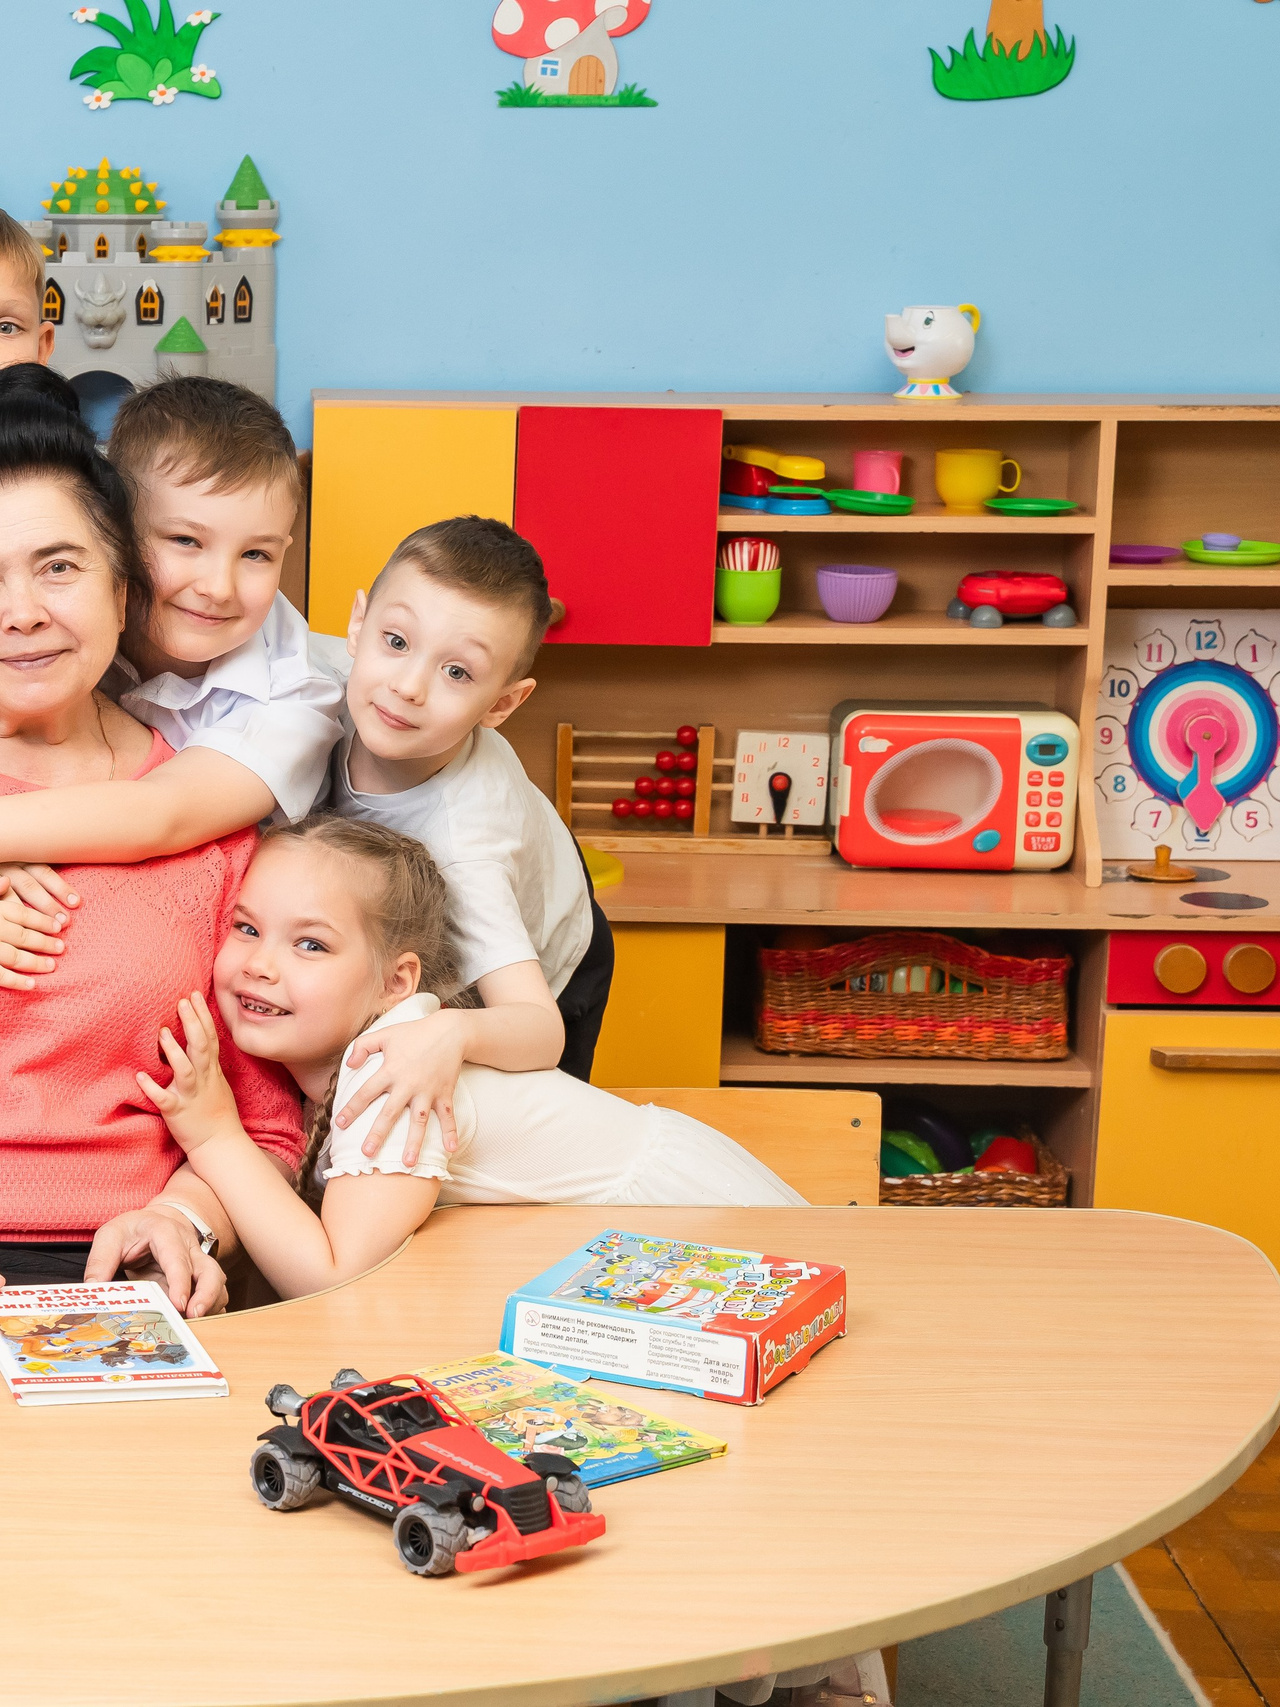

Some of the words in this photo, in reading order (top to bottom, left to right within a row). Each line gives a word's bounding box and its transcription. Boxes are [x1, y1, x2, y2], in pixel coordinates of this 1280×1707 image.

[1195, 631, 1217, 650] 12
[1146, 643, 1163, 662] 11
[1251, 644, 1258, 662] 1
[1109, 679, 1130, 698] 10
[778, 737, 790, 748] 12
[1100, 727, 1113, 745] 9
[802, 744, 806, 753] 1
[743, 754, 754, 763] 10
[812, 757, 820, 767] 2
[816, 776, 824, 787] 3
[1113, 775, 1126, 793] 8
[755, 807, 762, 817] 7
[792, 809, 800, 819] 5
[1149, 811, 1162, 828] 7
[1245, 811, 1258, 828] 5
[722, 1272, 764, 1312] пазлы
[742, 1269, 802, 1319] Весёлые
[576, 1318, 585, 1326] Не
[586, 1320, 635, 1334] рекомендовать
[541, 1322, 561, 1331] детям
[591, 1331, 605, 1340] игра
[606, 1334, 637, 1344] содержит
[541, 1332, 564, 1341] мелкие
[565, 1335, 589, 1345] детали.
[649, 1328, 661, 1336] Срок
[663, 1331, 685, 1339] годности
[766, 1327, 810, 1373] Весёлые
[810, 1298, 844, 1340] пазлы
[648, 1335, 661, 1343] Срок
[662, 1338, 682, 1347] службы
[523, 1347, 548, 1356] протереть
[549, 1351, 569, 1359] изделие
[524, 1338, 540, 1347] Перед
[540, 1342, 580, 1352] использованием
[581, 1349, 618, 1360] рекомендуется
[648, 1343, 663, 1351] Товар
[665, 1346, 701, 1357] сертифициров
[648, 1350, 678, 1360] Сохраняйте
[647, 1358, 679, 1368] предприятия
[704, 1357, 720, 1366] Дата
[721, 1362, 740, 1370] изгот.
[141, 1372, 203, 1380] ШКОЛЬНАЯ
[646, 1370, 659, 1378] Дата
[709, 1369, 733, 1378] январь
[442, 1370, 539, 1399] ПЕСЕН
[337, 1482, 394, 1513] SPEEDER
